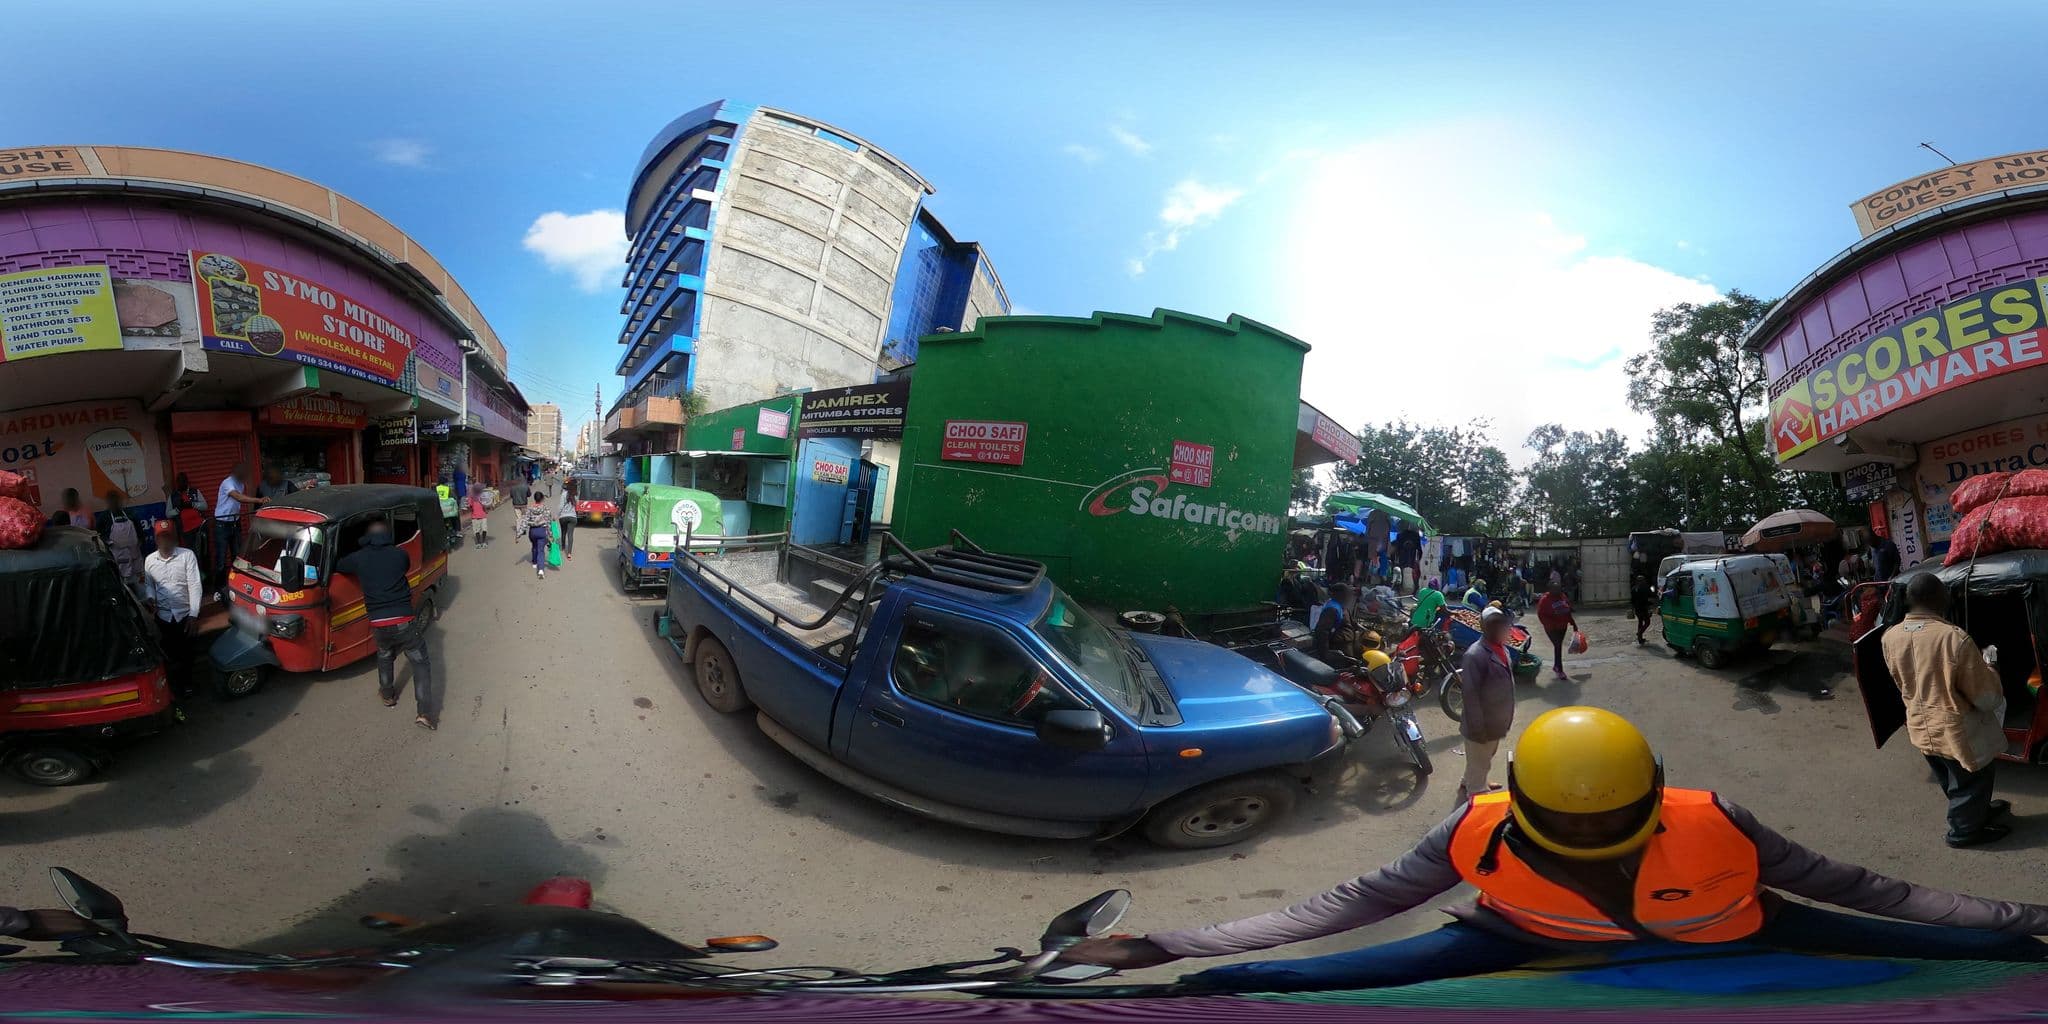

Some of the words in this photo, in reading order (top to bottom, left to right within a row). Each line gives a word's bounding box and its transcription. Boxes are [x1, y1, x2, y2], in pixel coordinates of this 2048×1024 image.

[1867, 166, 1977, 209] COMFY
[1876, 179, 1976, 220] GUEST
[1993, 167, 2048, 184] HO
[0, 277, 45, 288] GENERAL
[47, 272, 102, 282] HARDWARE
[2, 284, 52, 296] PLUMBING
[54, 280, 101, 289] SUPPLIES
[4, 294, 39, 304] PAINTS
[41, 289, 95, 298] SOLUTIONS
[6, 303, 32, 313] HDPE
[35, 298, 79, 309] FITTINGS
[263, 270, 337, 311] SYMO
[343, 300, 413, 349] MITUMBA
[9, 311, 42, 323] TOILET
[45, 308, 70, 317] SETS
[11, 318, 65, 332] BATHROOM
[67, 316, 91, 325] SETS
[13, 329, 40, 342] HAND
[42, 327, 74, 337] TOOLS
[322, 314, 385, 354] STORE
[15, 338, 49, 352] WATER
[51, 336, 84, 346] PUMPS
[220, 339, 244, 350] CALL:
[295, 329, 361, 358] (WHOLESALE
[362, 352, 368, 361] &
[1813, 288, 2039, 411] SCORES
[1818, 331, 2043, 436] HARDWARE
[807, 393, 890, 410] JAMIREX
[802, 410, 851, 420] MITUMBA
[853, 407, 902, 417] STORES
[949, 425, 987, 438] CHOO
[991, 426, 1022, 440] SAFI
[381, 436, 414, 446] LODGING
[946, 441, 977, 450] CLEAN
[979, 442, 1020, 453] TOILETS
[1933, 428, 2024, 460] SCORES
[1174, 444, 1195, 463] CHOO
[1196, 449, 1212, 467] SAFI
[815, 461, 834, 473] CHOO
[835, 465, 848, 476] SAFI
[1847, 463, 1877, 480] CHOO
[1866, 465, 1892, 483] SAFI
[1128, 486, 1280, 535] Safaricom
